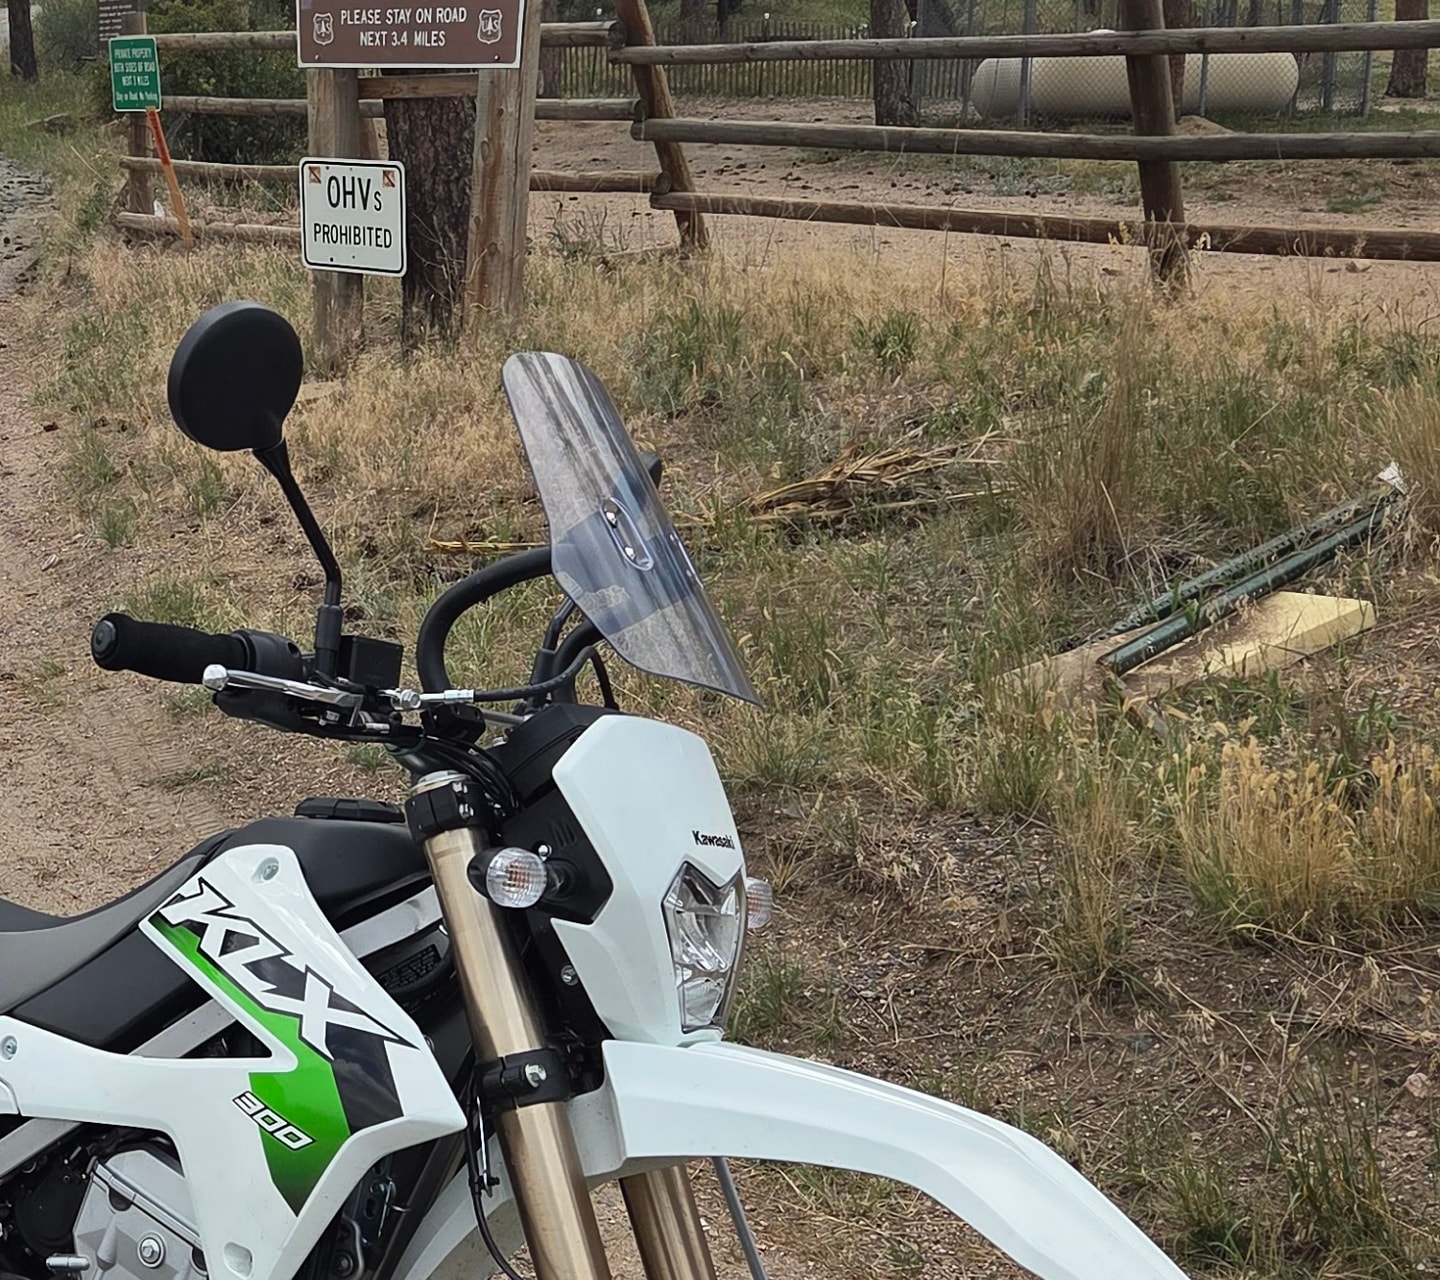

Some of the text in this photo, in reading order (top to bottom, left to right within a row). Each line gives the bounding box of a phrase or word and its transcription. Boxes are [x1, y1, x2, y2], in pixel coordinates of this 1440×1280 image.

[341, 7, 467, 24] PLEASE STAY ON ROAD
[360, 30, 446, 46] NEXT 3.4 MILES
[327, 175, 382, 211] OHVs
[313, 222, 392, 249] PROHIBITED
[692, 830, 735, 850] Kawasaki
[158, 877, 412, 1060] KLX
[232, 1091, 317, 1151] 300
